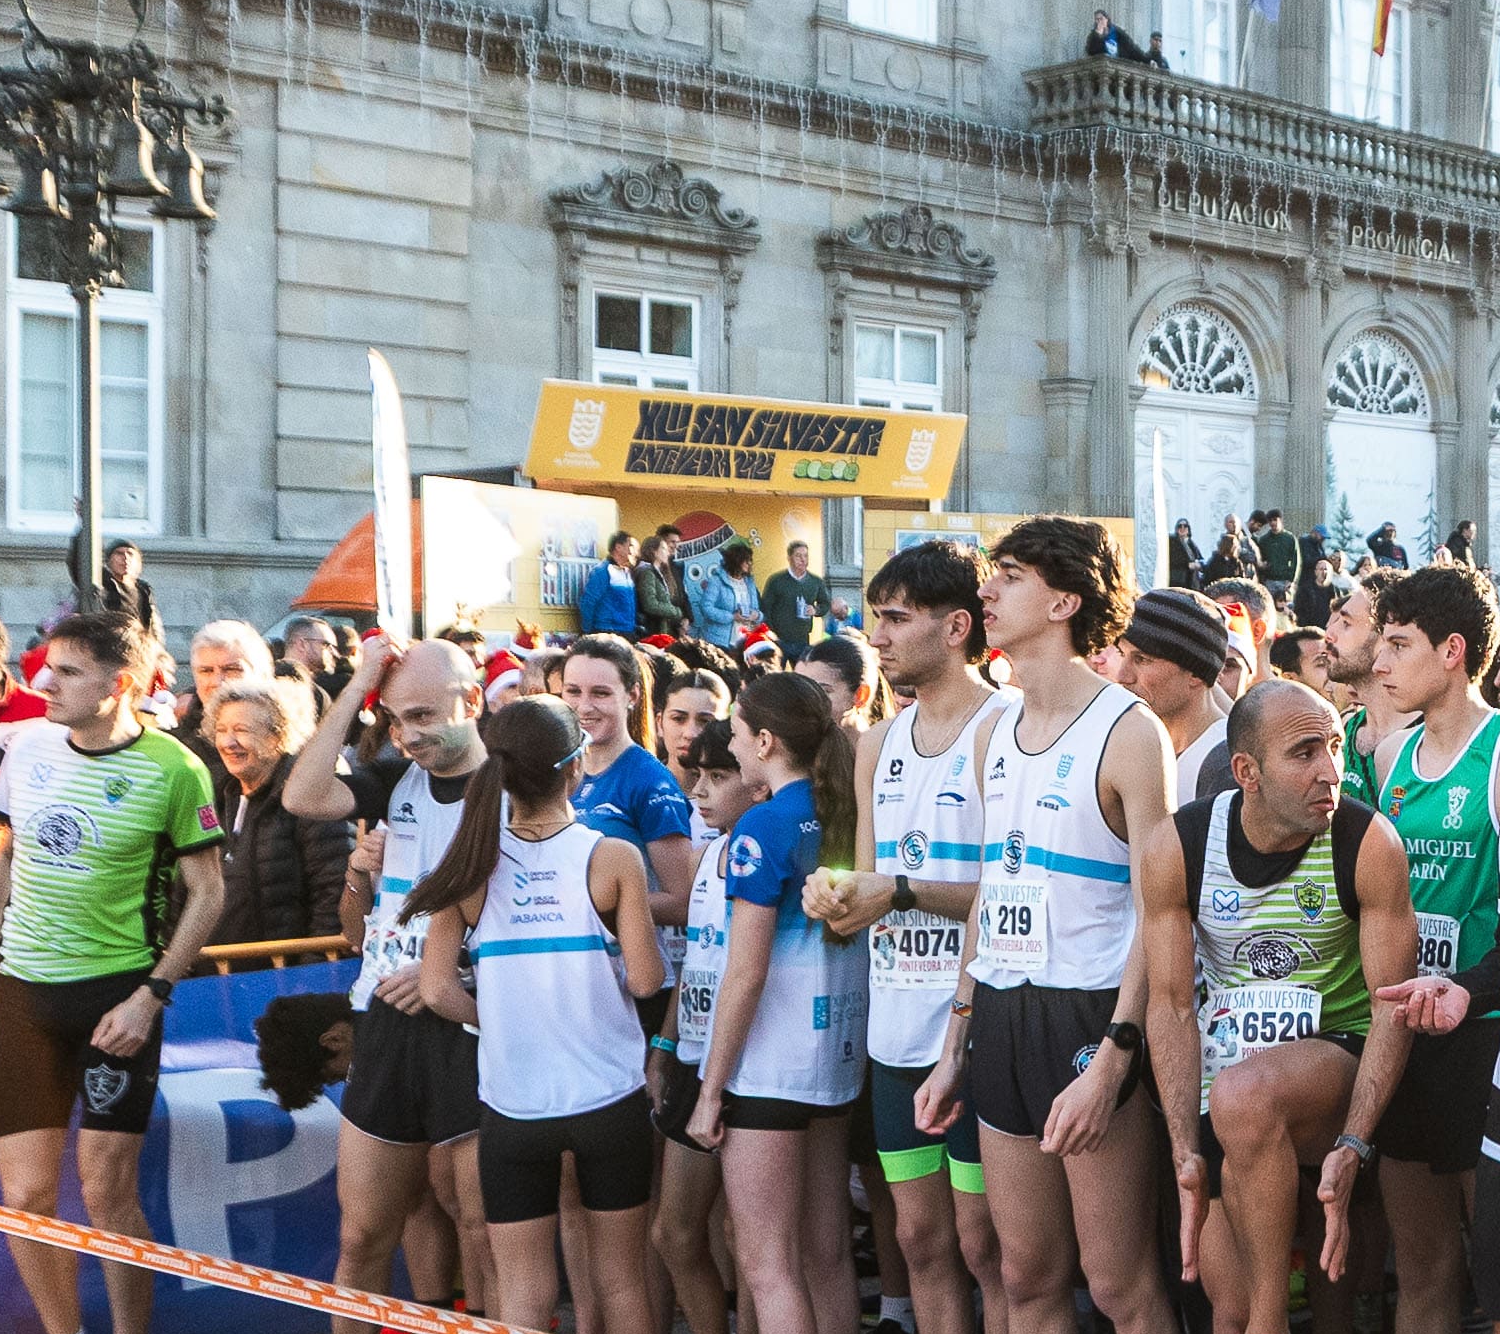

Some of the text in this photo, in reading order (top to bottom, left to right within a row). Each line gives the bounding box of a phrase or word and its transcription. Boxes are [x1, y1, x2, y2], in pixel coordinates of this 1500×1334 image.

[689, 405, 753, 445] SAN
[741, 409, 886, 457] SILVESTRE
[1405, 838, 1476, 859] MIGUEL
[1410, 859, 1448, 881] ARÍN
[1000, 885, 1045, 903] SILVESTRE
[512, 912, 564, 924] ABANCA
[998, 905, 1032, 936] 219
[899, 928, 961, 958] 4074
[1233, 992, 1257, 1009] SAN
[1258, 989, 1316, 1009] SILVESTRE
[1242, 1012, 1315, 1043] 6520
